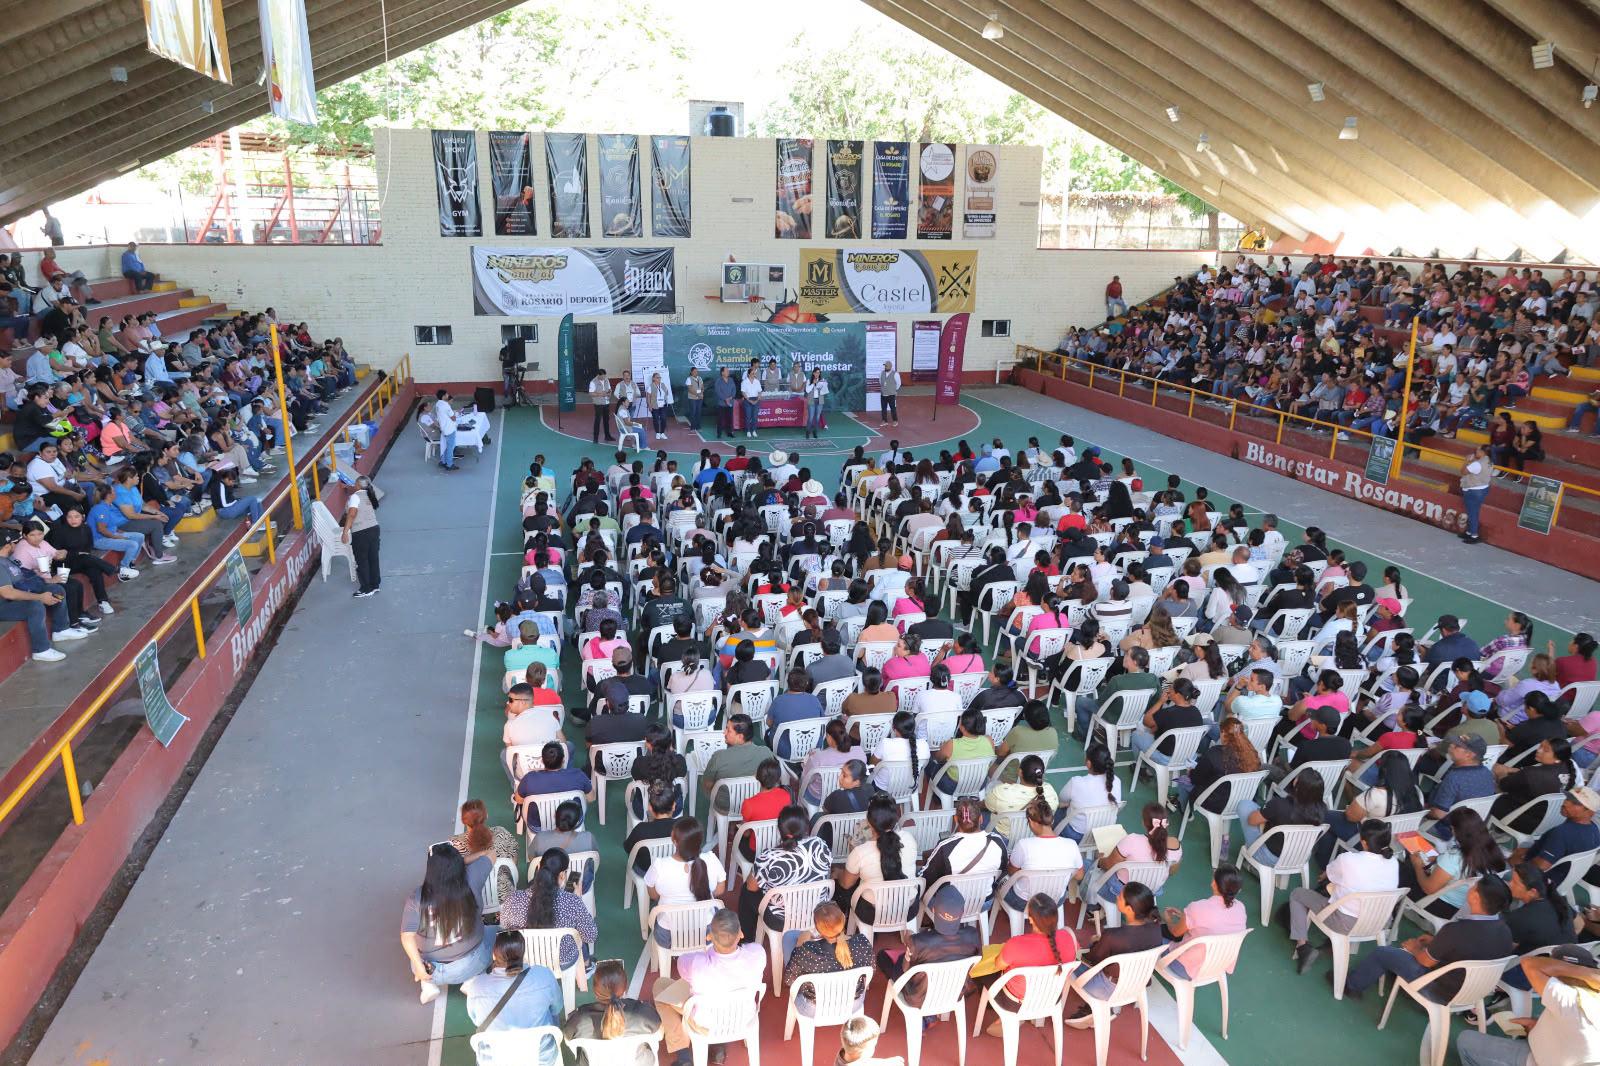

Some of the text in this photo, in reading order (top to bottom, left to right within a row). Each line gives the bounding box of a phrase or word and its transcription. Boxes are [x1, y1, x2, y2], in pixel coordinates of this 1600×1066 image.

[847, 253, 899, 263] MINEROS
[629, 267, 673, 296] Black
[802, 288, 838, 296] MASTER
[861, 283, 925, 302] Castel
[521, 297, 563, 306] ROSARIO
[570, 296, 609, 304] DEPORTE
[708, 328, 730, 336] México
[716, 345, 747, 354] Sorteo
[716, 355, 758, 363] Asamble
[791, 351, 834, 362] Vivienda
[804, 361, 853, 372] Bienestar
[1246, 441, 1340, 488] Bienestar
[230, 575, 287, 677] Bienestar
